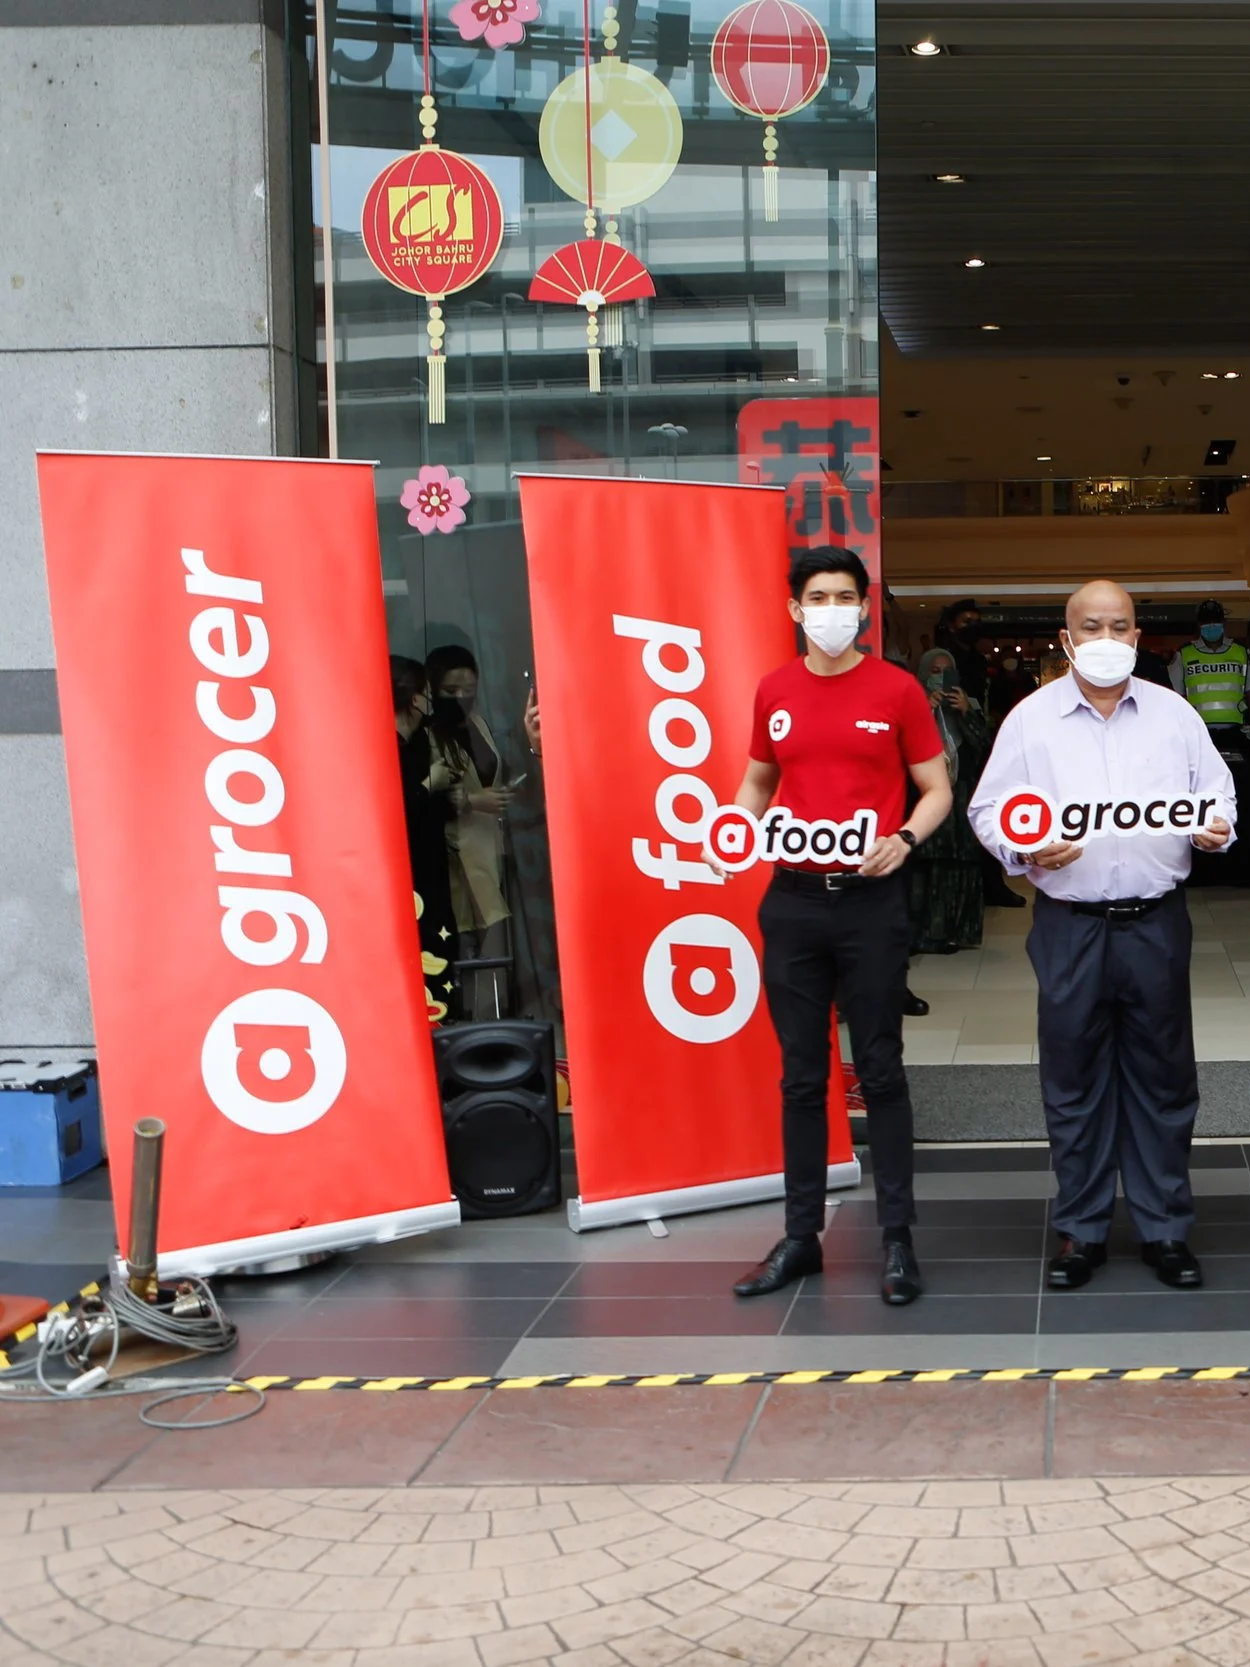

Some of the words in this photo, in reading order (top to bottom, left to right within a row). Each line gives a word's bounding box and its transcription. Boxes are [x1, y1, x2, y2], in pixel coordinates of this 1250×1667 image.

[391, 246, 431, 257] JOHOR
[436, 244, 474, 255] BAHRU
[393, 256, 421, 267] CITY
[426, 254, 473, 266] SQUARE
[1187, 663, 1243, 676] SECURITY
[180, 547, 328, 966] grocer
[612, 614, 725, 890] food
[765, 815, 868, 856] food
[1061, 798, 1216, 841] grocer
